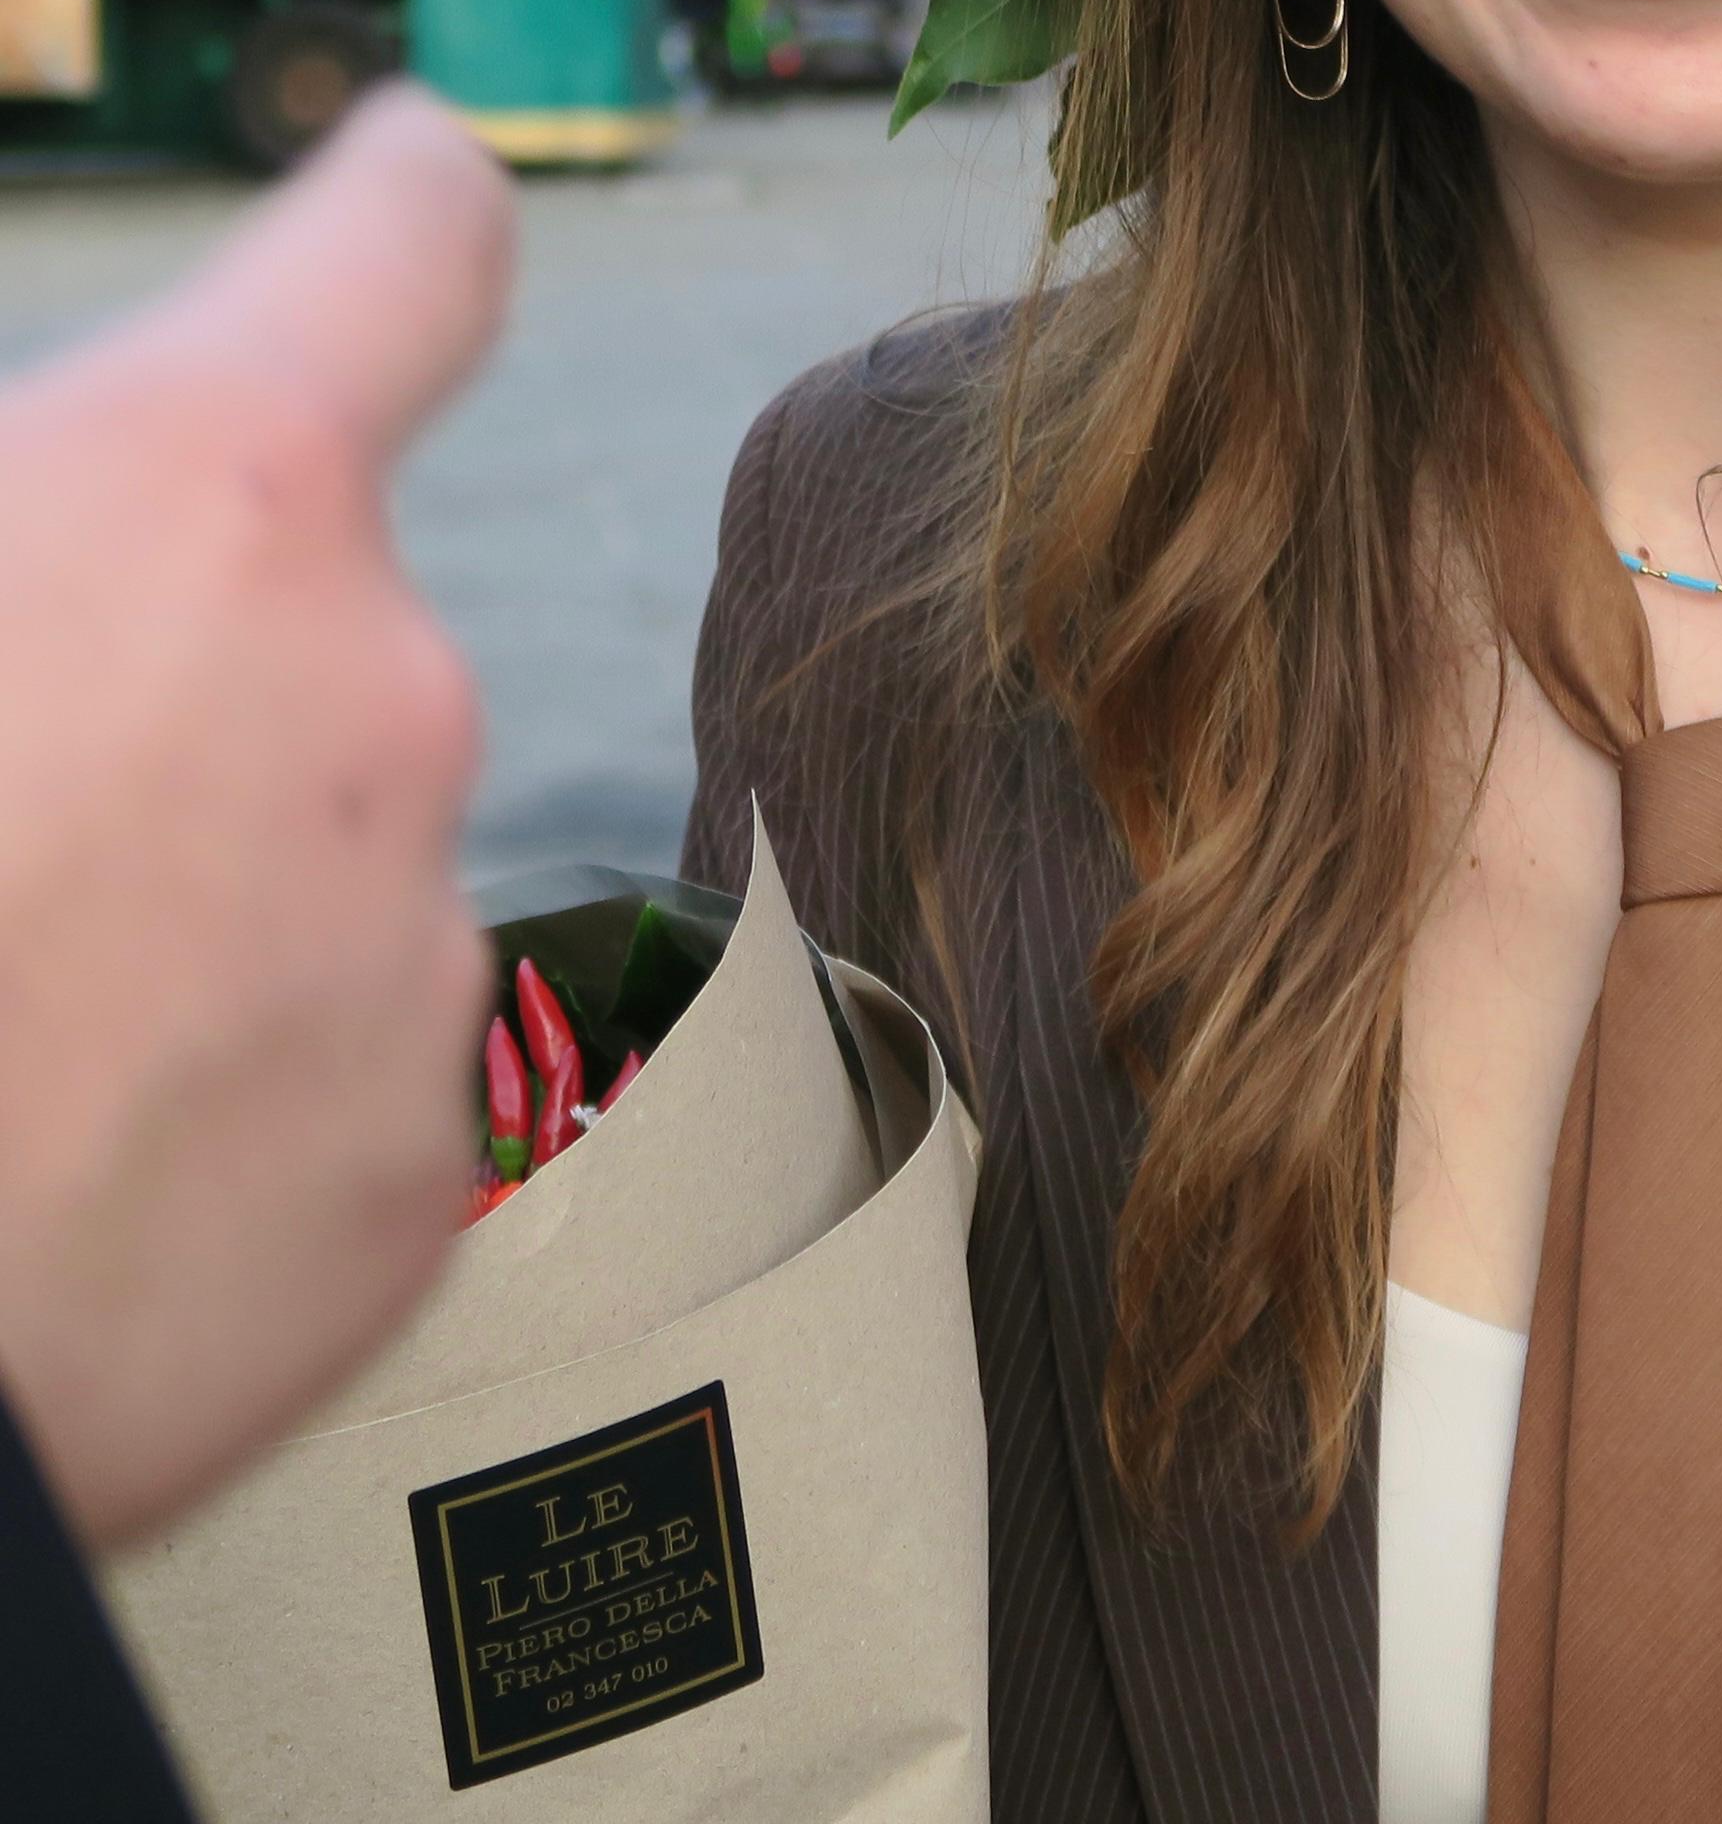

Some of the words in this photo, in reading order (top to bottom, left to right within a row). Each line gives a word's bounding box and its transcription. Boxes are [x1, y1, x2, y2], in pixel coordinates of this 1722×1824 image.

[535, 1483, 633, 1548] LE
[480, 1516, 699, 1625] LUIRE
[476, 1617, 591, 1672] PIERO
[605, 1570, 720, 1628] DELLA
[492, 1604, 712, 1698] FRANCESCA
[546, 1689, 575, 1714] 02
[584, 1672, 623, 1700] 347
[631, 1656, 669, 1684] 010
